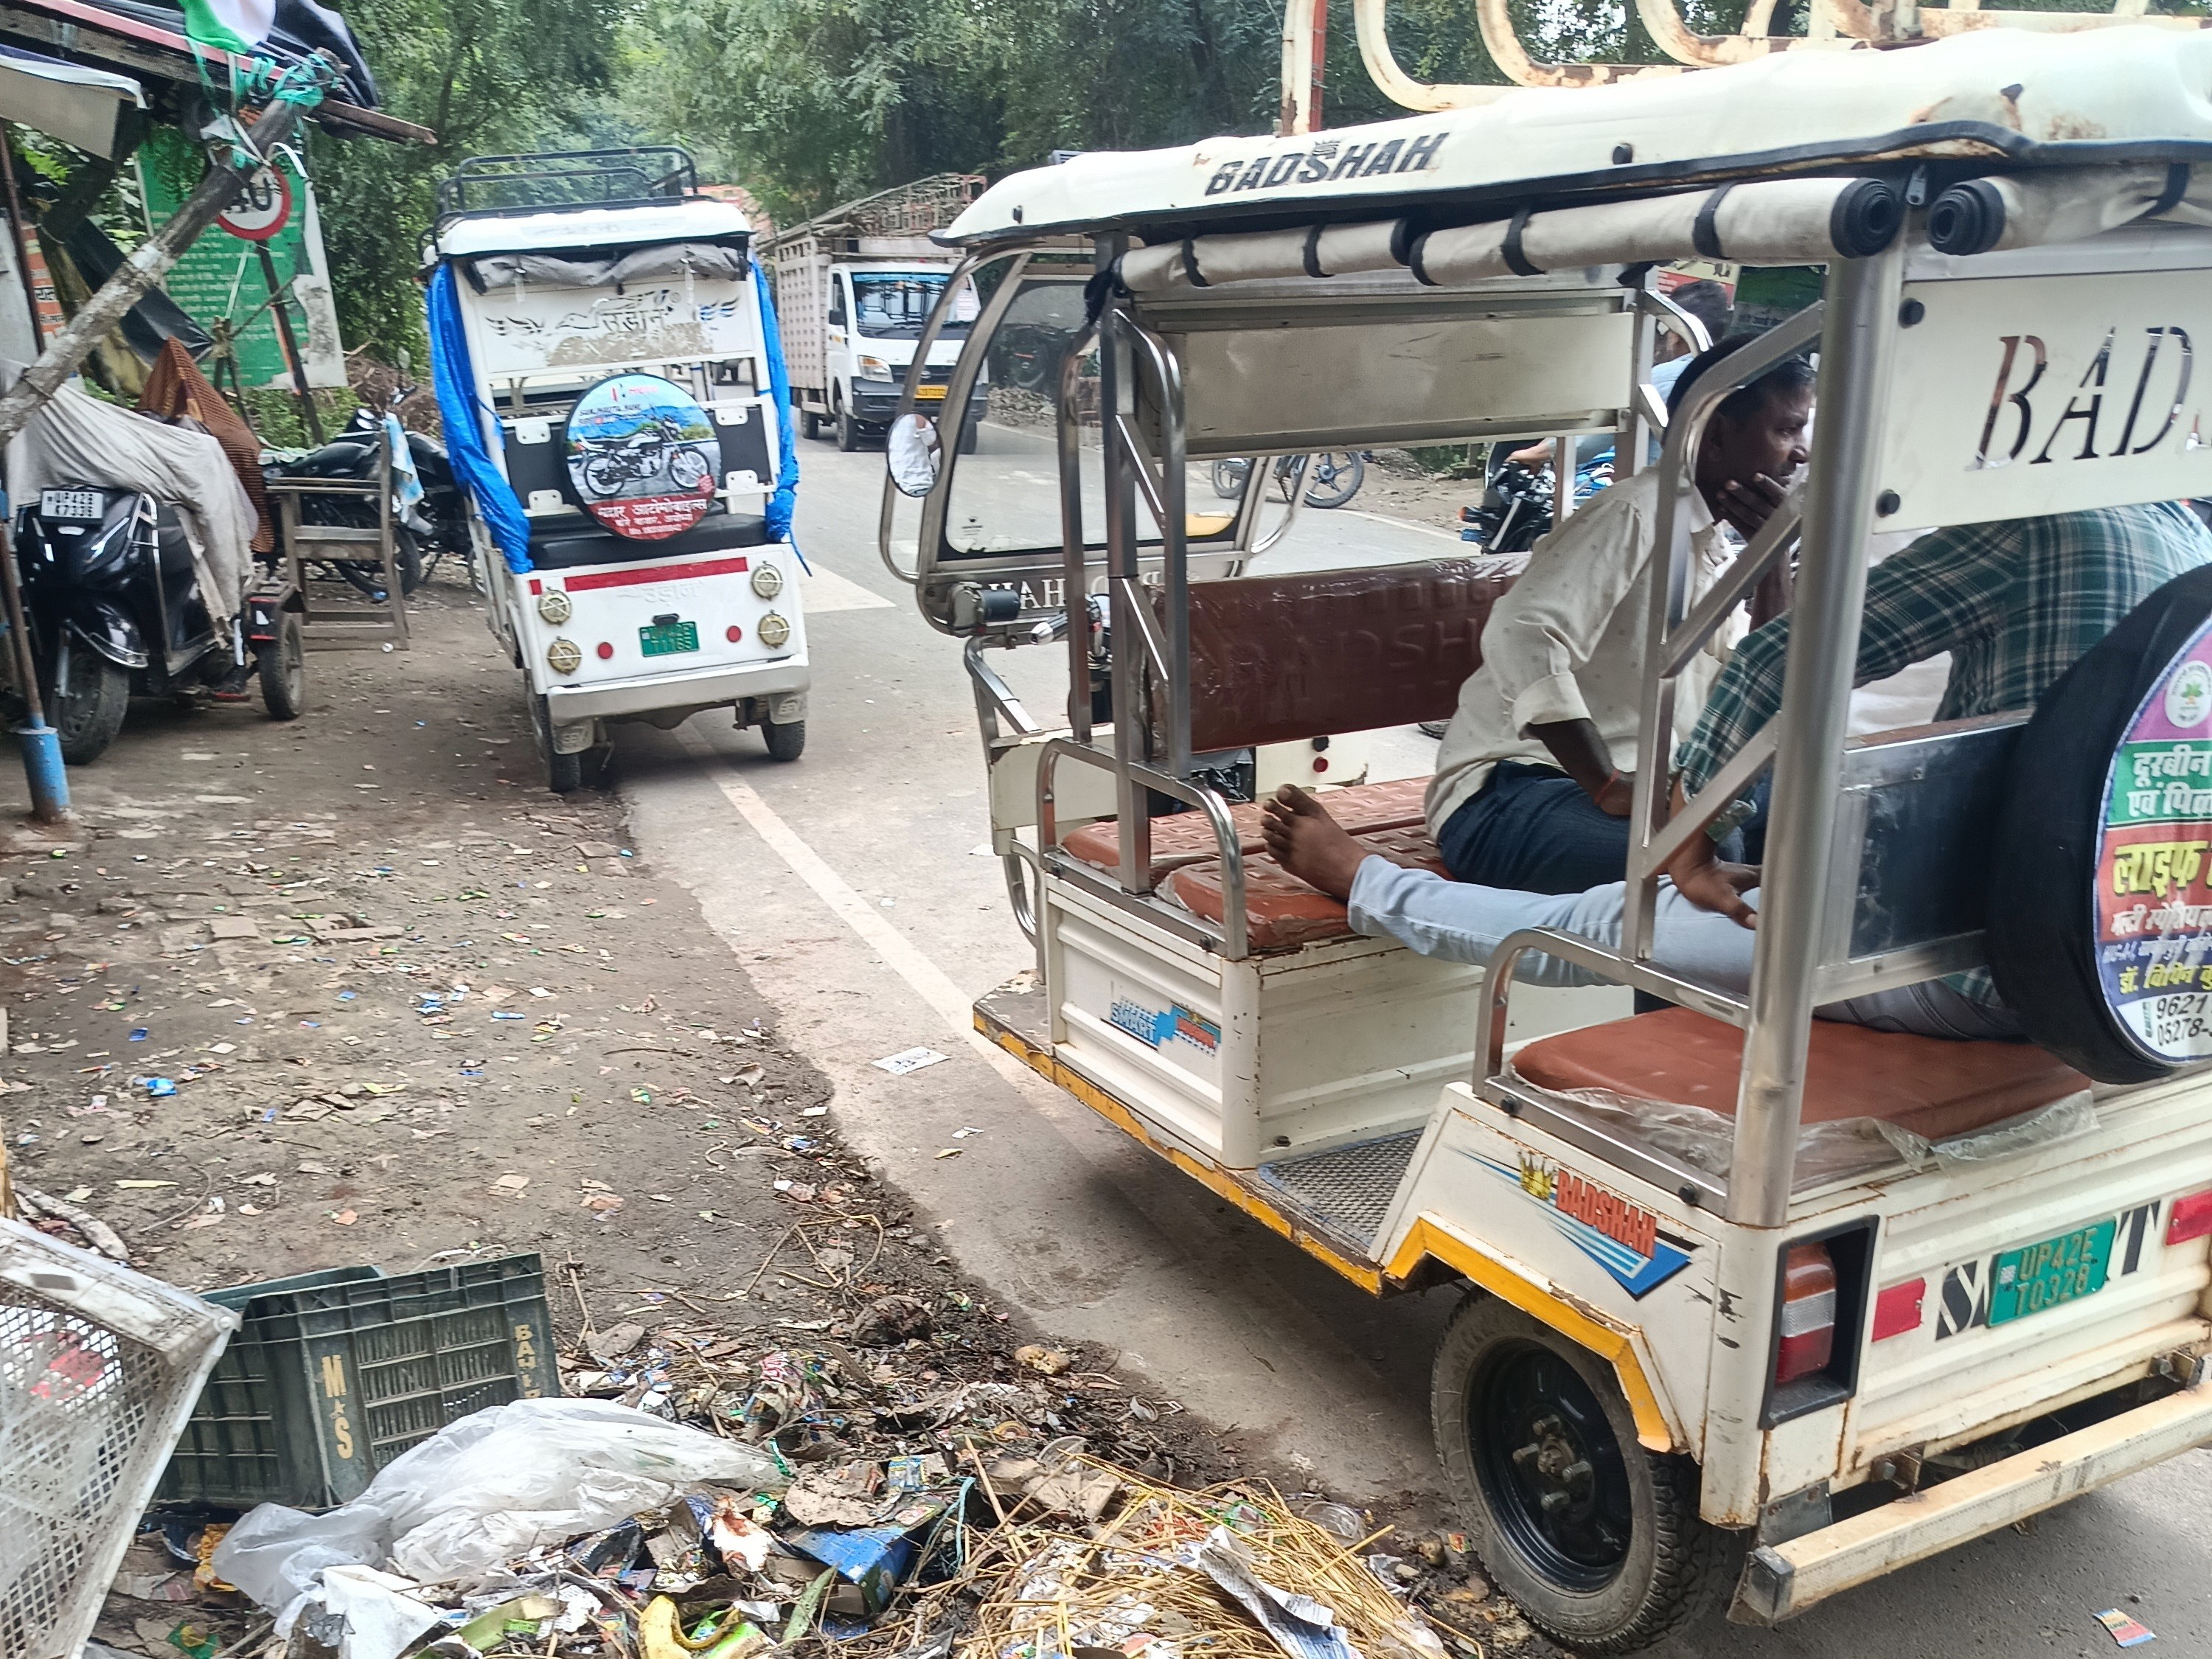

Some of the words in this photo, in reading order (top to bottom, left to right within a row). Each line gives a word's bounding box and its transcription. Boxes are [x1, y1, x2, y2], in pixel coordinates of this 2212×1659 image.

[1205, 133, 1450, 196] BADSHAH
[1963, 325, 2212, 472] BAD
[2113, 840, 2209, 899] लाइफ
[2157, 994, 2212, 1020] 9621
[2157, 1018, 2212, 1046] 05278-
[1556, 1167, 1657, 1261] BADSHAH
[2018, 1226, 2098, 1281] UP42E
[2014, 1262, 2090, 1317] T0328
